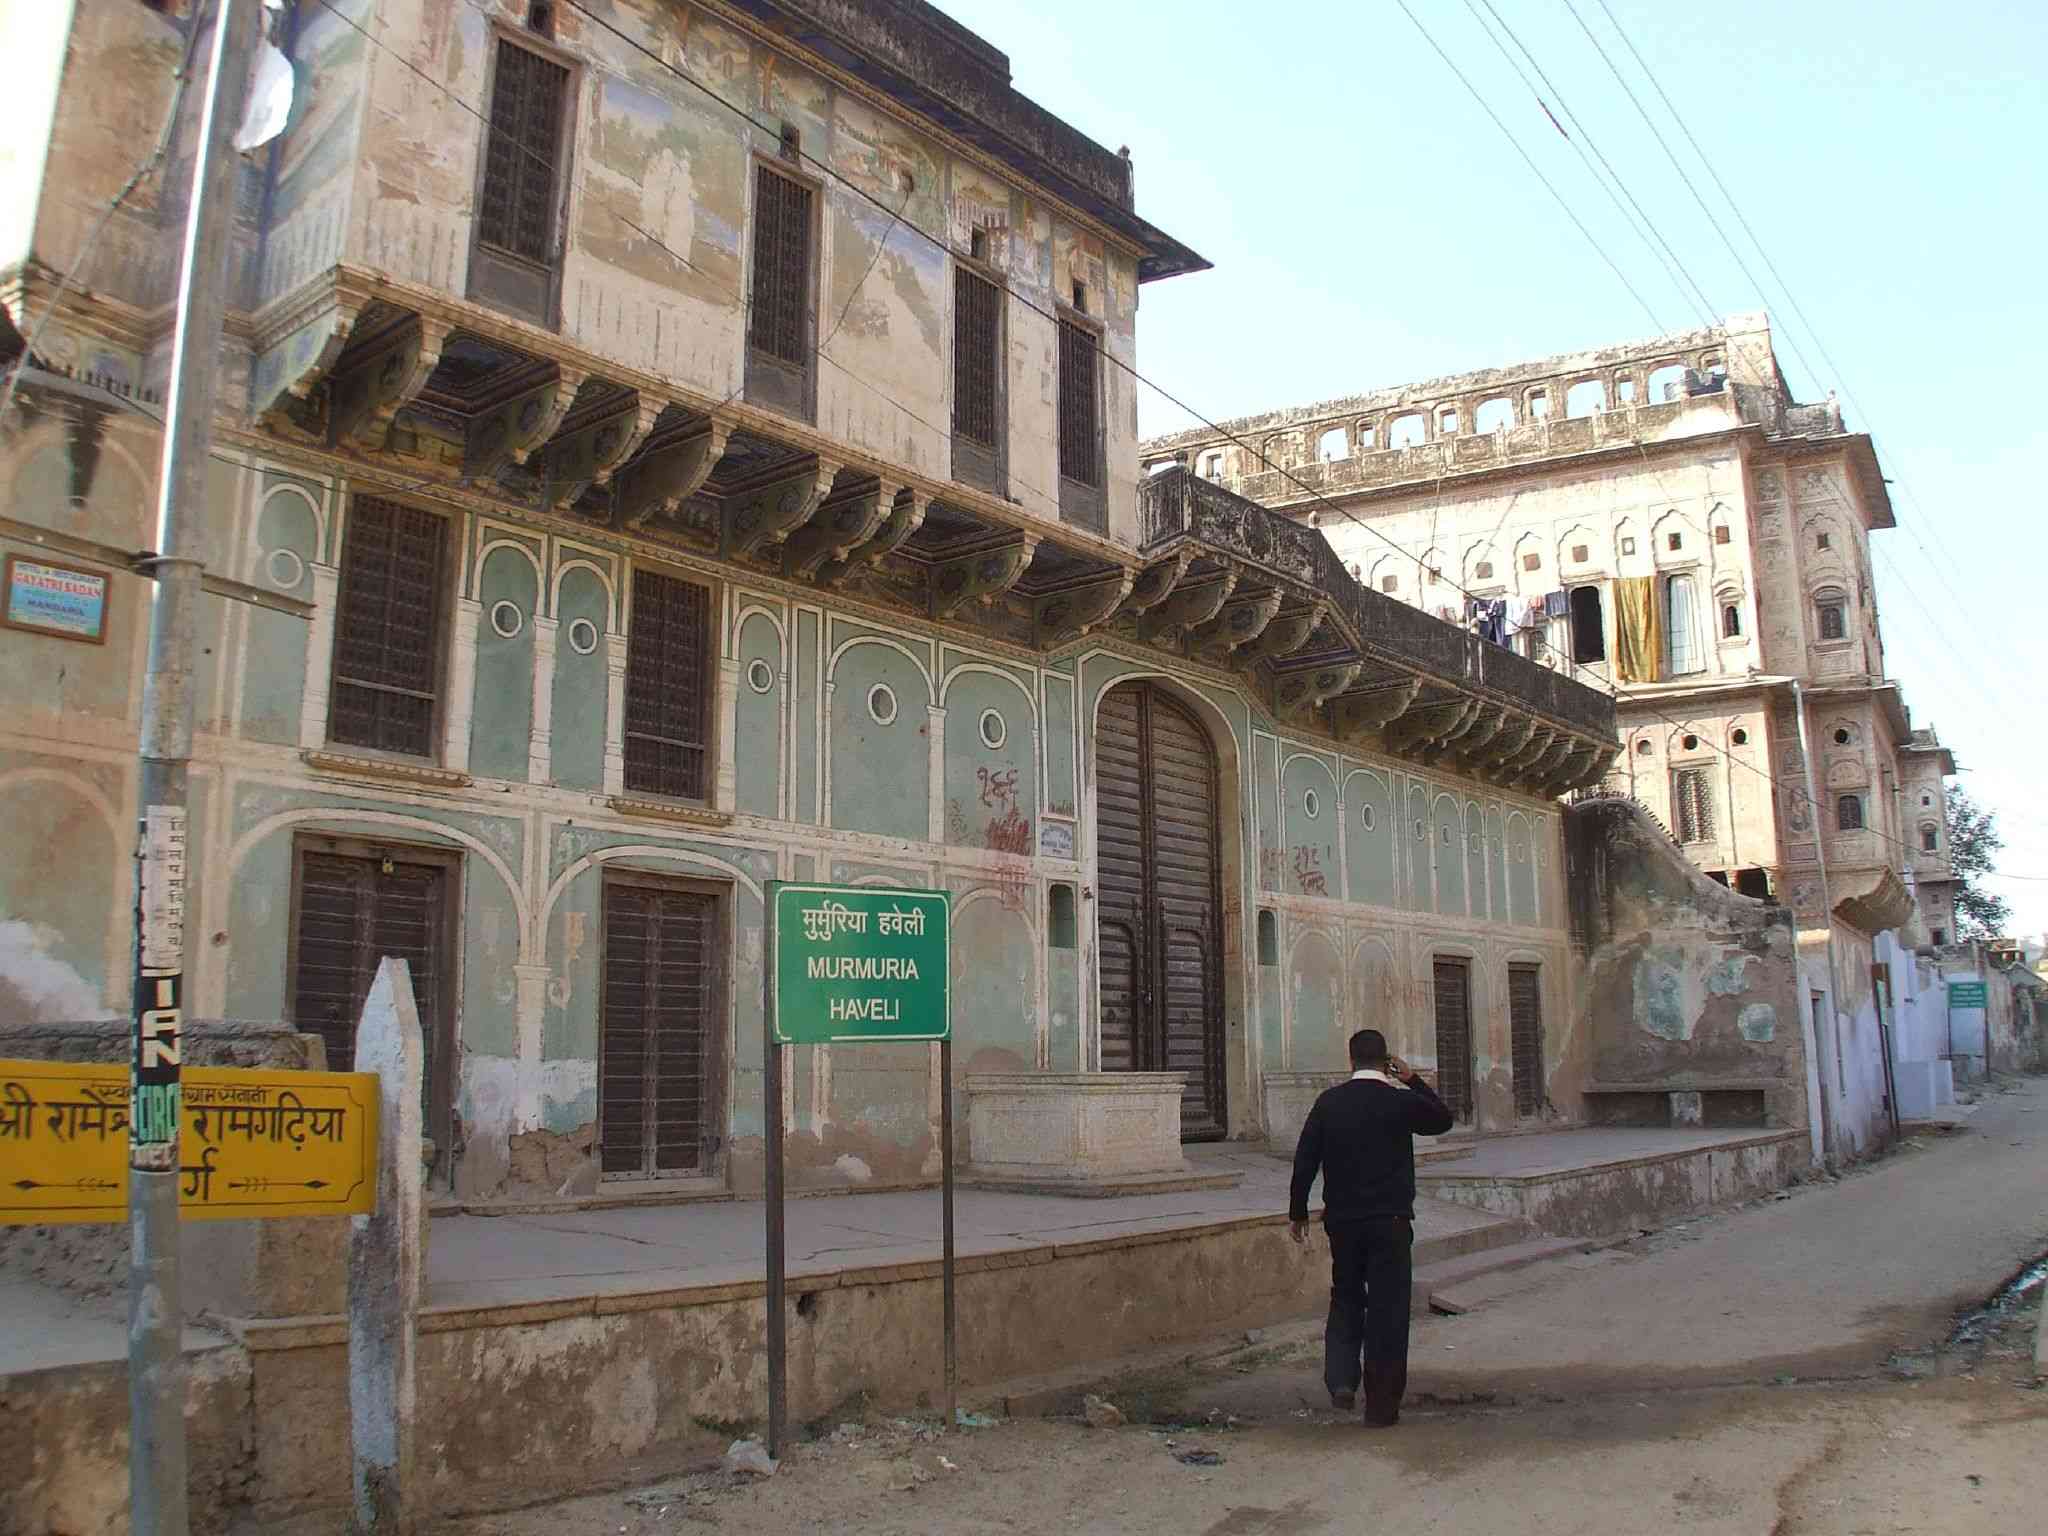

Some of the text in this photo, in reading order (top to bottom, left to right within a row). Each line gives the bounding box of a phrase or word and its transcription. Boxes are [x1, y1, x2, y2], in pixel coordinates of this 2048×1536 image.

[802, 900, 926, 941] मुर्मुरिया हवेली
[807, 956, 920, 980] MURMURIA
[830, 998, 900, 1021] HAVELI
[186, 1091, 346, 1152] रामगढ़िया
